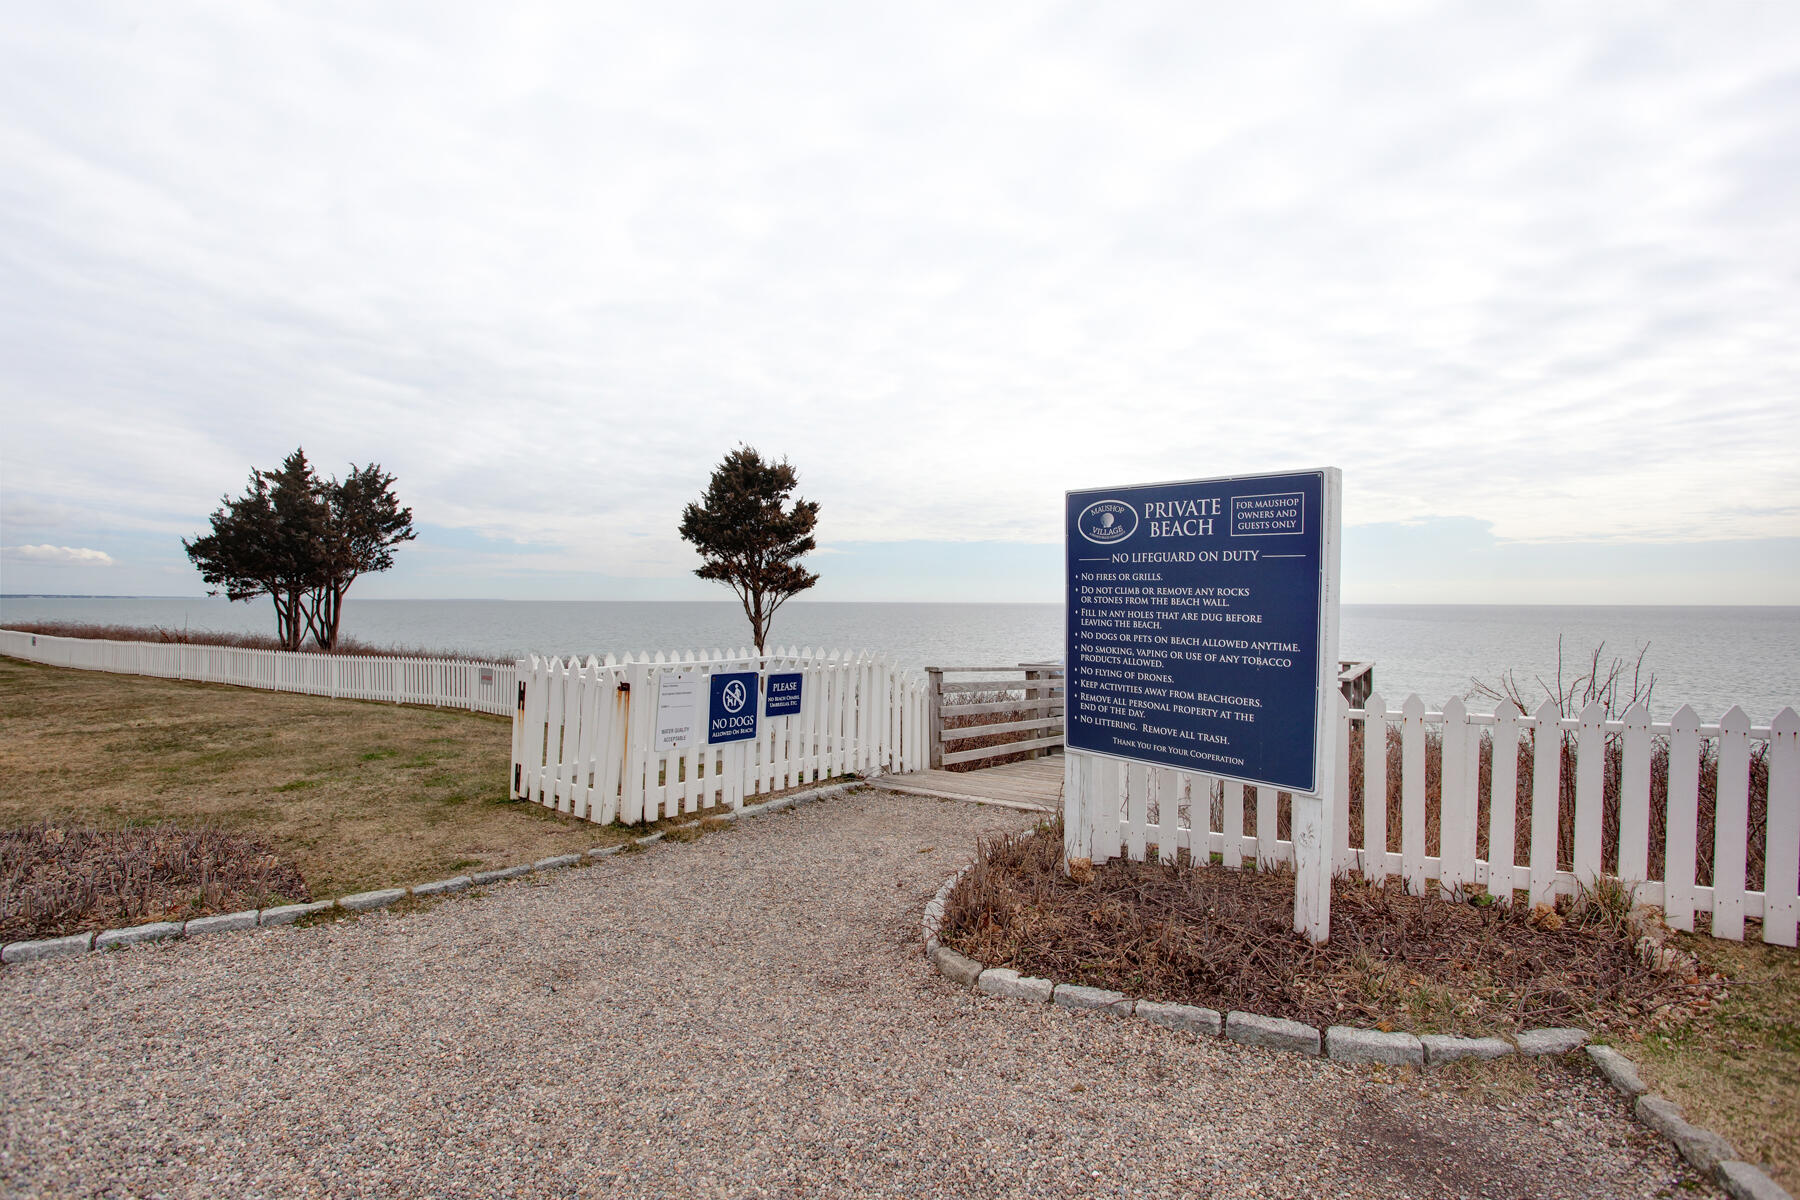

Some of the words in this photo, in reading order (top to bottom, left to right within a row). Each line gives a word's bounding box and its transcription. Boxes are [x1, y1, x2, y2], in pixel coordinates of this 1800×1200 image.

[1090, 504, 1125, 516] MAUSHOP
[1144, 498, 1221, 518] PRIVATE
[1236, 502, 1253, 510] FOR
[1254, 498, 1300, 508] MAUSHOP
[1238, 510, 1274, 520] OWNERS
[1276, 509, 1296, 518] AND
[1092, 525, 1124, 536] VILLAGE
[1150, 519, 1214, 538] BEACH
[1238, 522, 1270, 530] GUESTS
[1272, 520, 1296, 528] ONLY
[1112, 553, 1129, 563] NO
[1132, 552, 1195, 562] LIFEGUARD
[1199, 551, 1219, 562] ON
[1222, 550, 1259, 562] DUTY
[1132, 573, 1163, 581] GRILLS.
[1114, 587, 1140, 595] CLIMB
[1142, 587, 1154, 595] OR
[1156, 588, 1192, 596] REMOVE
[1218, 588, 1250, 596] ROCKS
[1094, 596, 1123, 604] STONES
[1170, 598, 1200, 606] BEACH
[1202, 598, 1230, 606] WALL.
[1098, 609, 1108, 617] IN
[1109, 610, 1126, 618] ANY
[1128, 610, 1154, 618] HOLES
[1156, 611, 1180, 620] THAT
[1180, 612, 1198, 620] ARE
[1201, 612, 1222, 622] DUG
[1226, 614, 1262, 623] BEFORE
[1081, 618, 1112, 627] LEAVING
[1114, 620, 1130, 628] THE
[1133, 620, 1162, 629] BEACH.
[1096, 632, 1118, 640] DOGS
[1120, 634, 1132, 642] OR
[1134, 634, 1152, 642] PETS
[1154, 636, 1168, 644] ON
[1170, 637, 1200, 646] BEACH
[1202, 638, 1248, 649] ALLOWED
[1250, 641, 1300, 652] ANYTIME.
[1080, 654, 1120, 664] PRODUCTS
[1122, 658, 1164, 668] ALLOWED.
[1136, 648, 1168, 658] VAPING
[1170, 651, 1184, 660] OR
[1186, 652, 1202, 661] USE
[1204, 653, 1216, 662] OF
[1219, 654, 1240, 664] ANY
[1242, 656, 1292, 668] TOBACCO
[1096, 668, 1122, 678] FLYING
[1124, 671, 1136, 679] OF
[1138, 672, 1174, 683] DRONES.
[773, 682, 797, 692] PLEASE
[1100, 682, 1142, 694] ACTIVITIES
[1144, 687, 1168, 696] AWAY
[1170, 690, 1194, 700] FROM
[1198, 692, 1262, 708] BEACHGOERS.
[1080, 702, 1096, 712] END
[1098, 704, 1108, 713] OF
[1110, 706, 1126, 716] THE
[1128, 708, 1146, 718] DAY.
[1113, 698, 1126, 706] ALL
[1129, 699, 1170, 712] PERSONAL
[1173, 704, 1218, 718] PROPERTY
[1220, 710, 1232, 720] AT
[1234, 712, 1254, 722] THE
[712, 718, 728, 730] NO
[730, 714, 754, 728] DOGS
[1095, 718, 1138, 731] LITTERING.
[1179, 730, 1196, 740] ALL
[1198, 732, 1230, 744] TRASH.
[1113, 737, 1136, 748] THANK
[1137, 741, 1152, 750] YOU
[1154, 744, 1166, 753] FOR
[1168, 746, 1188, 757] YOUR
[1190, 750, 1244, 766] COOPERATION
